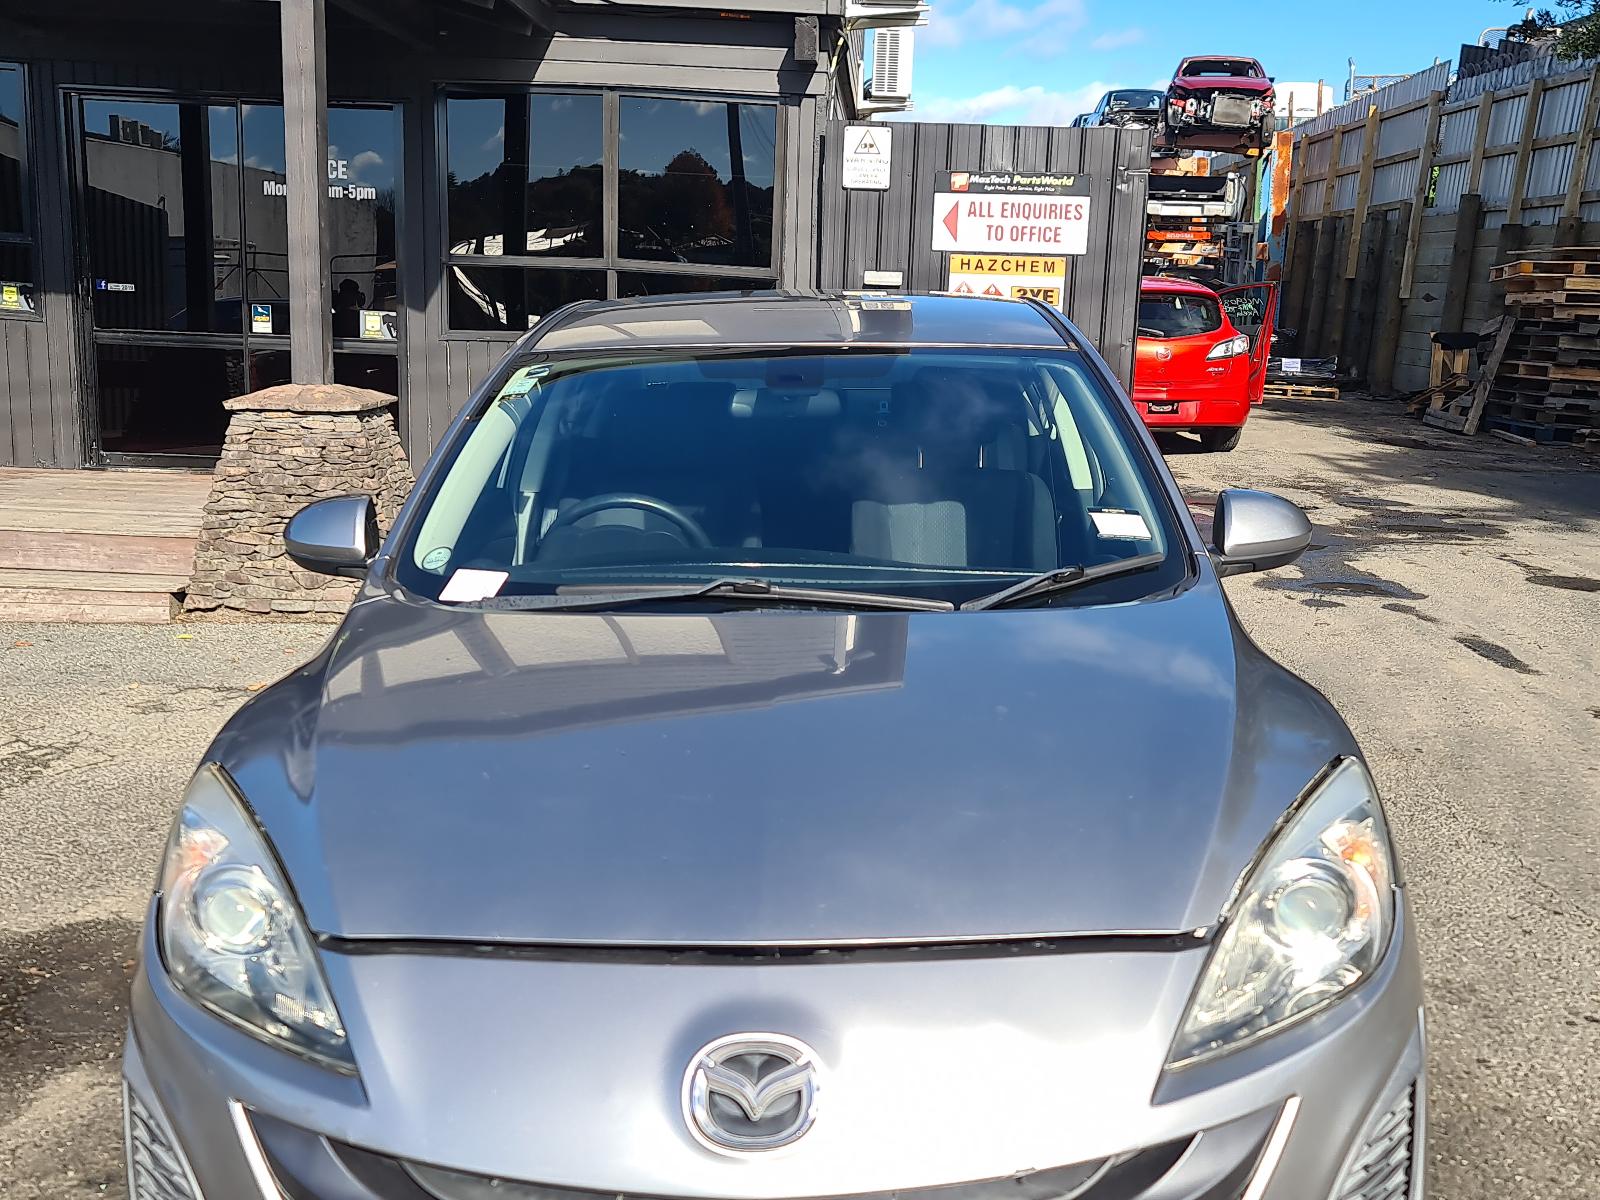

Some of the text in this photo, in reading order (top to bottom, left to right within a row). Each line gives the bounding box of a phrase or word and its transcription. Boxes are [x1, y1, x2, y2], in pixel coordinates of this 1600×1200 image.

[846, 156, 889, 165] WANG
[1013, 175, 1075, 186] PartsWorld
[328, 184, 376, 201] m-5pm
[967, 201, 1083, 221] ALL ENQUIRIES
[986, 225, 1062, 243] TO OFFICE
[960, 258, 1055, 273] HAZCHEM
